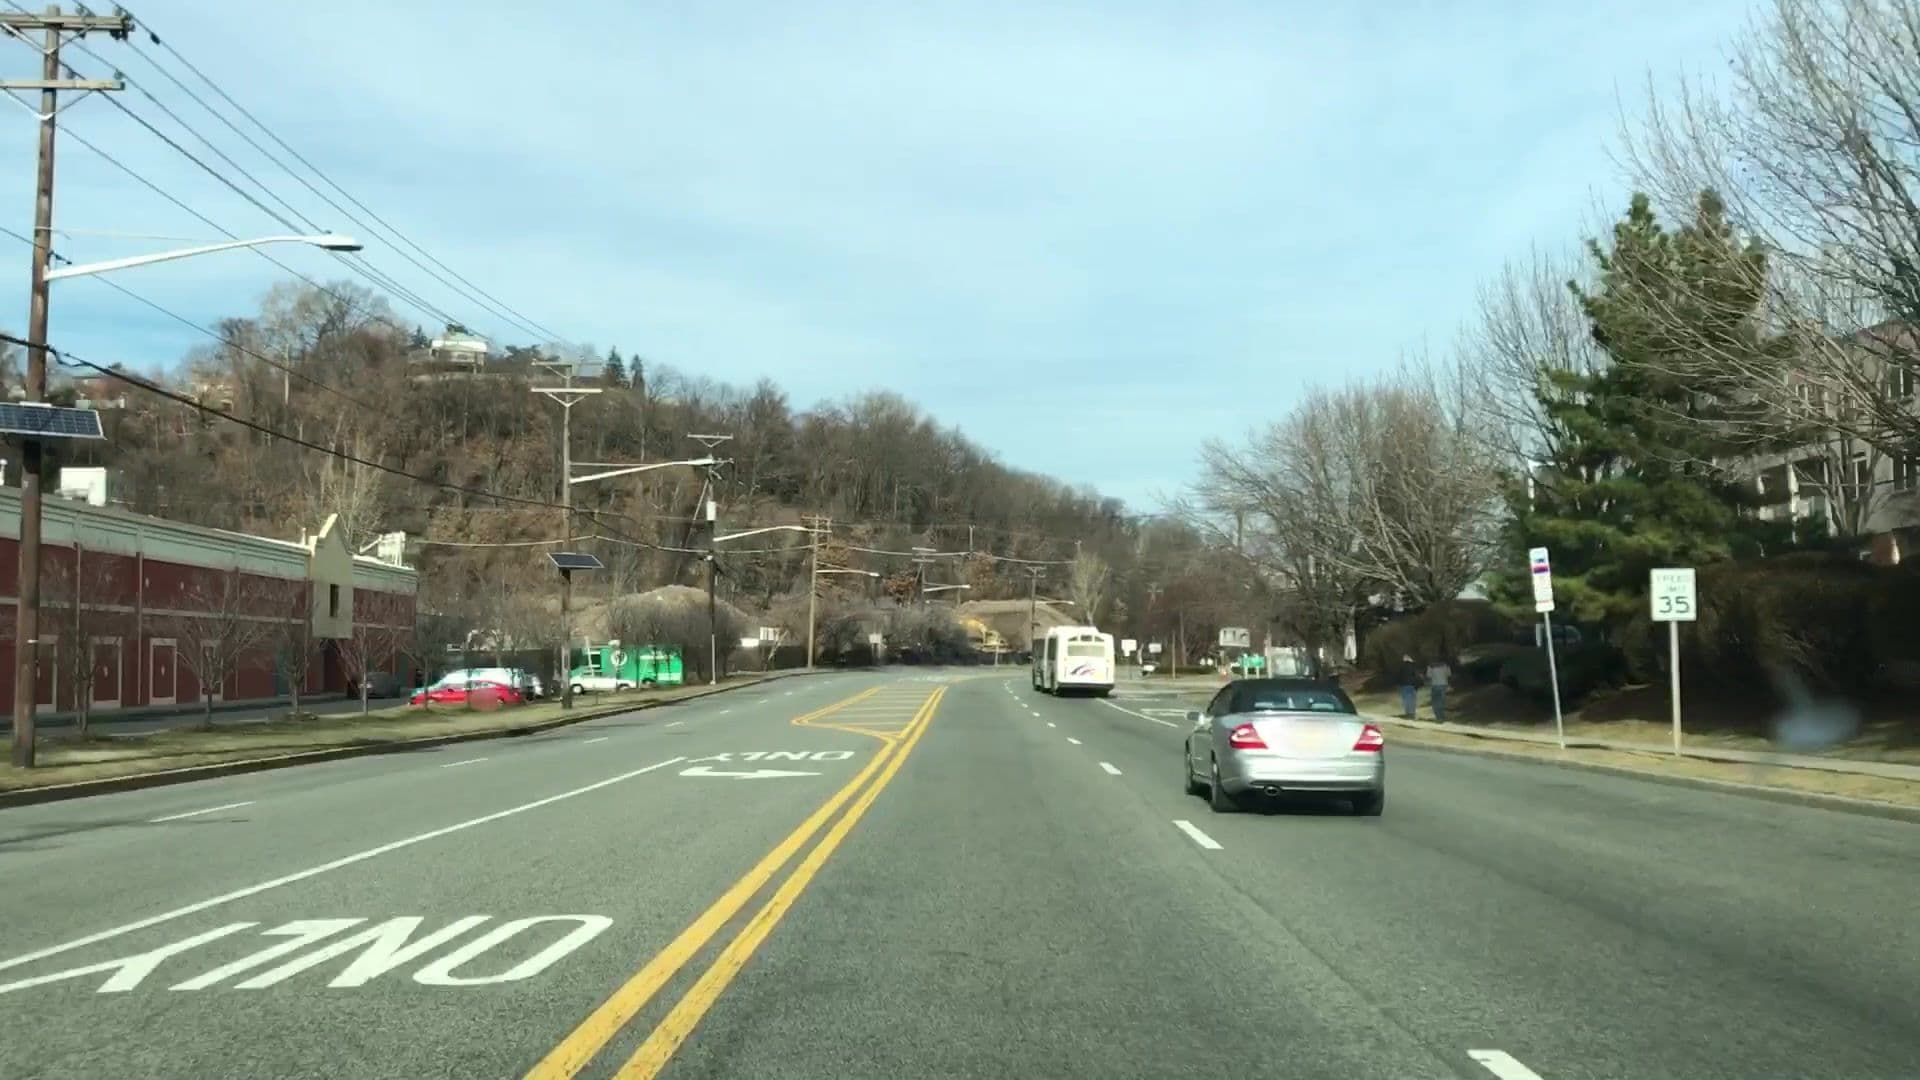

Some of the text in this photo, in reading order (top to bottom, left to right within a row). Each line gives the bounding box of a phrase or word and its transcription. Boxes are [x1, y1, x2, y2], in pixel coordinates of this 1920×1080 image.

[1658, 595, 1690, 614] 35
[687, 751, 855, 762] ONLY
[0, 914, 614, 993] ONLY
